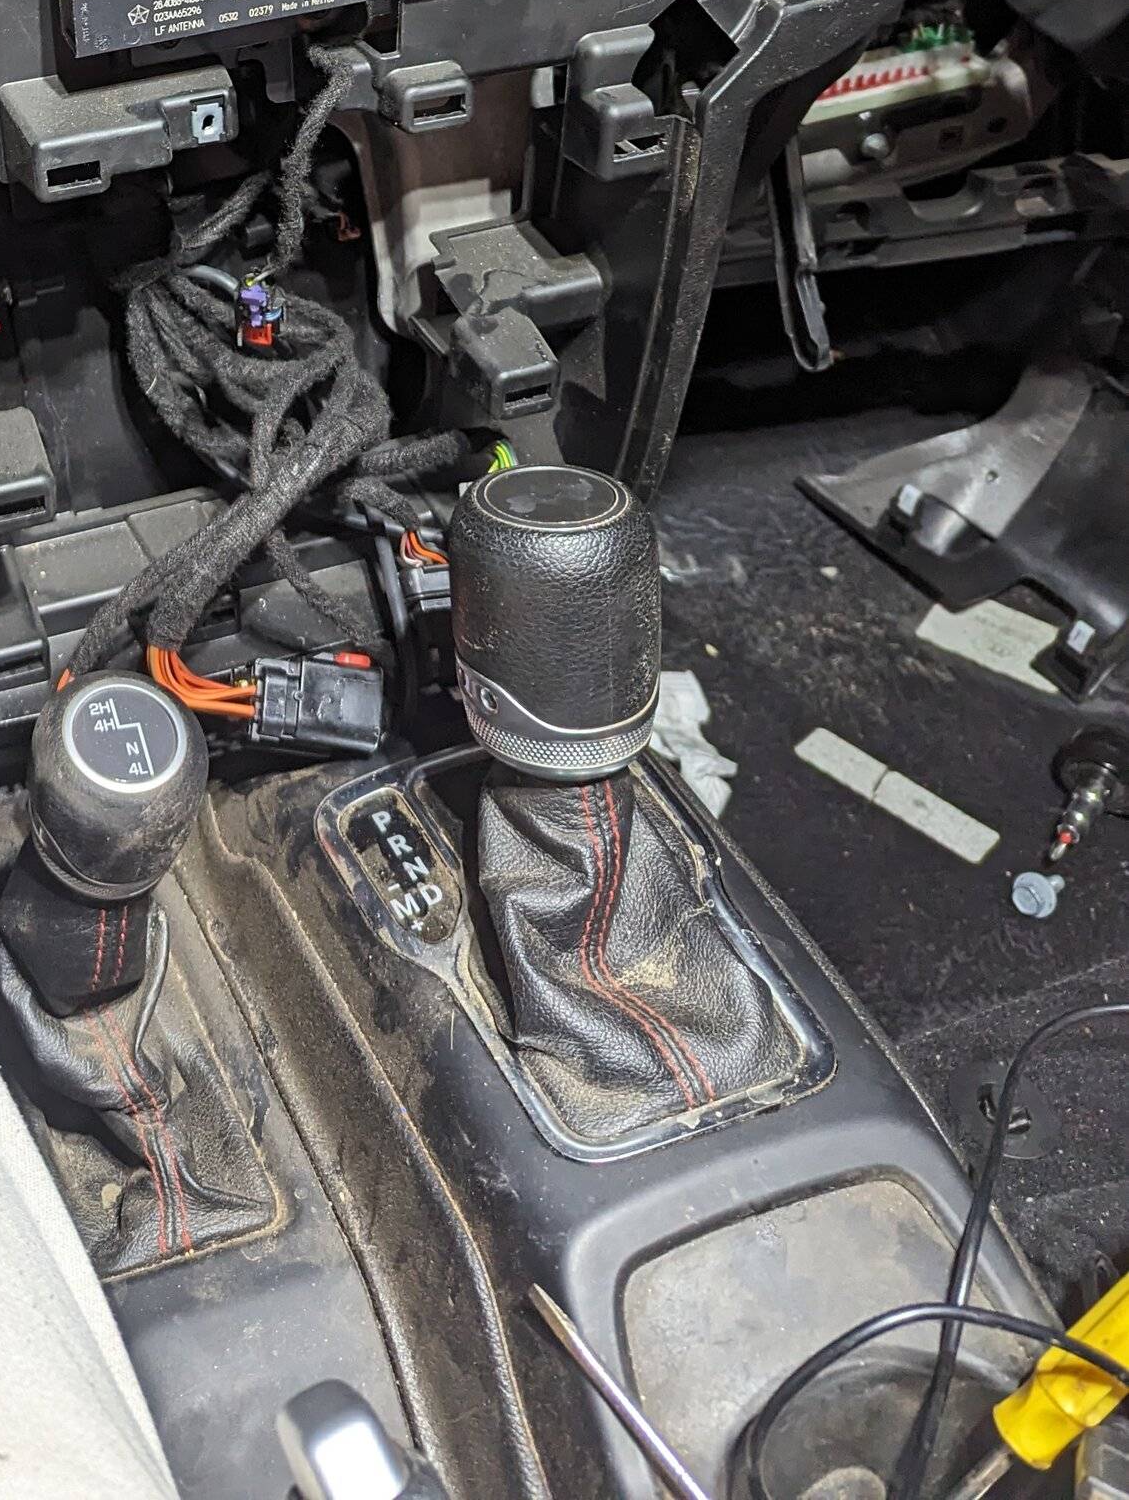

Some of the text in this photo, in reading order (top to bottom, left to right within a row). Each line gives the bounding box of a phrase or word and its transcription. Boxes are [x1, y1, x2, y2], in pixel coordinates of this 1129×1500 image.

[249, 5, 274, 18] 02379
[281, 1, 298, 12] Made
[301, 0, 309, 8] in
[154, 18, 205, 36] LF ANTENNA
[88, 702, 111, 717] 2H
[93, 717, 116, 733] 4H
[126, 740, 139, 756] N
[128, 761, 149, 777] 4L
[371, 811, 392, 833] P
[387, 834, 413, 858] R
[403, 857, 430, 882] N
[421, 883, 444, 907] D
[389, 896, 420, 921] M
